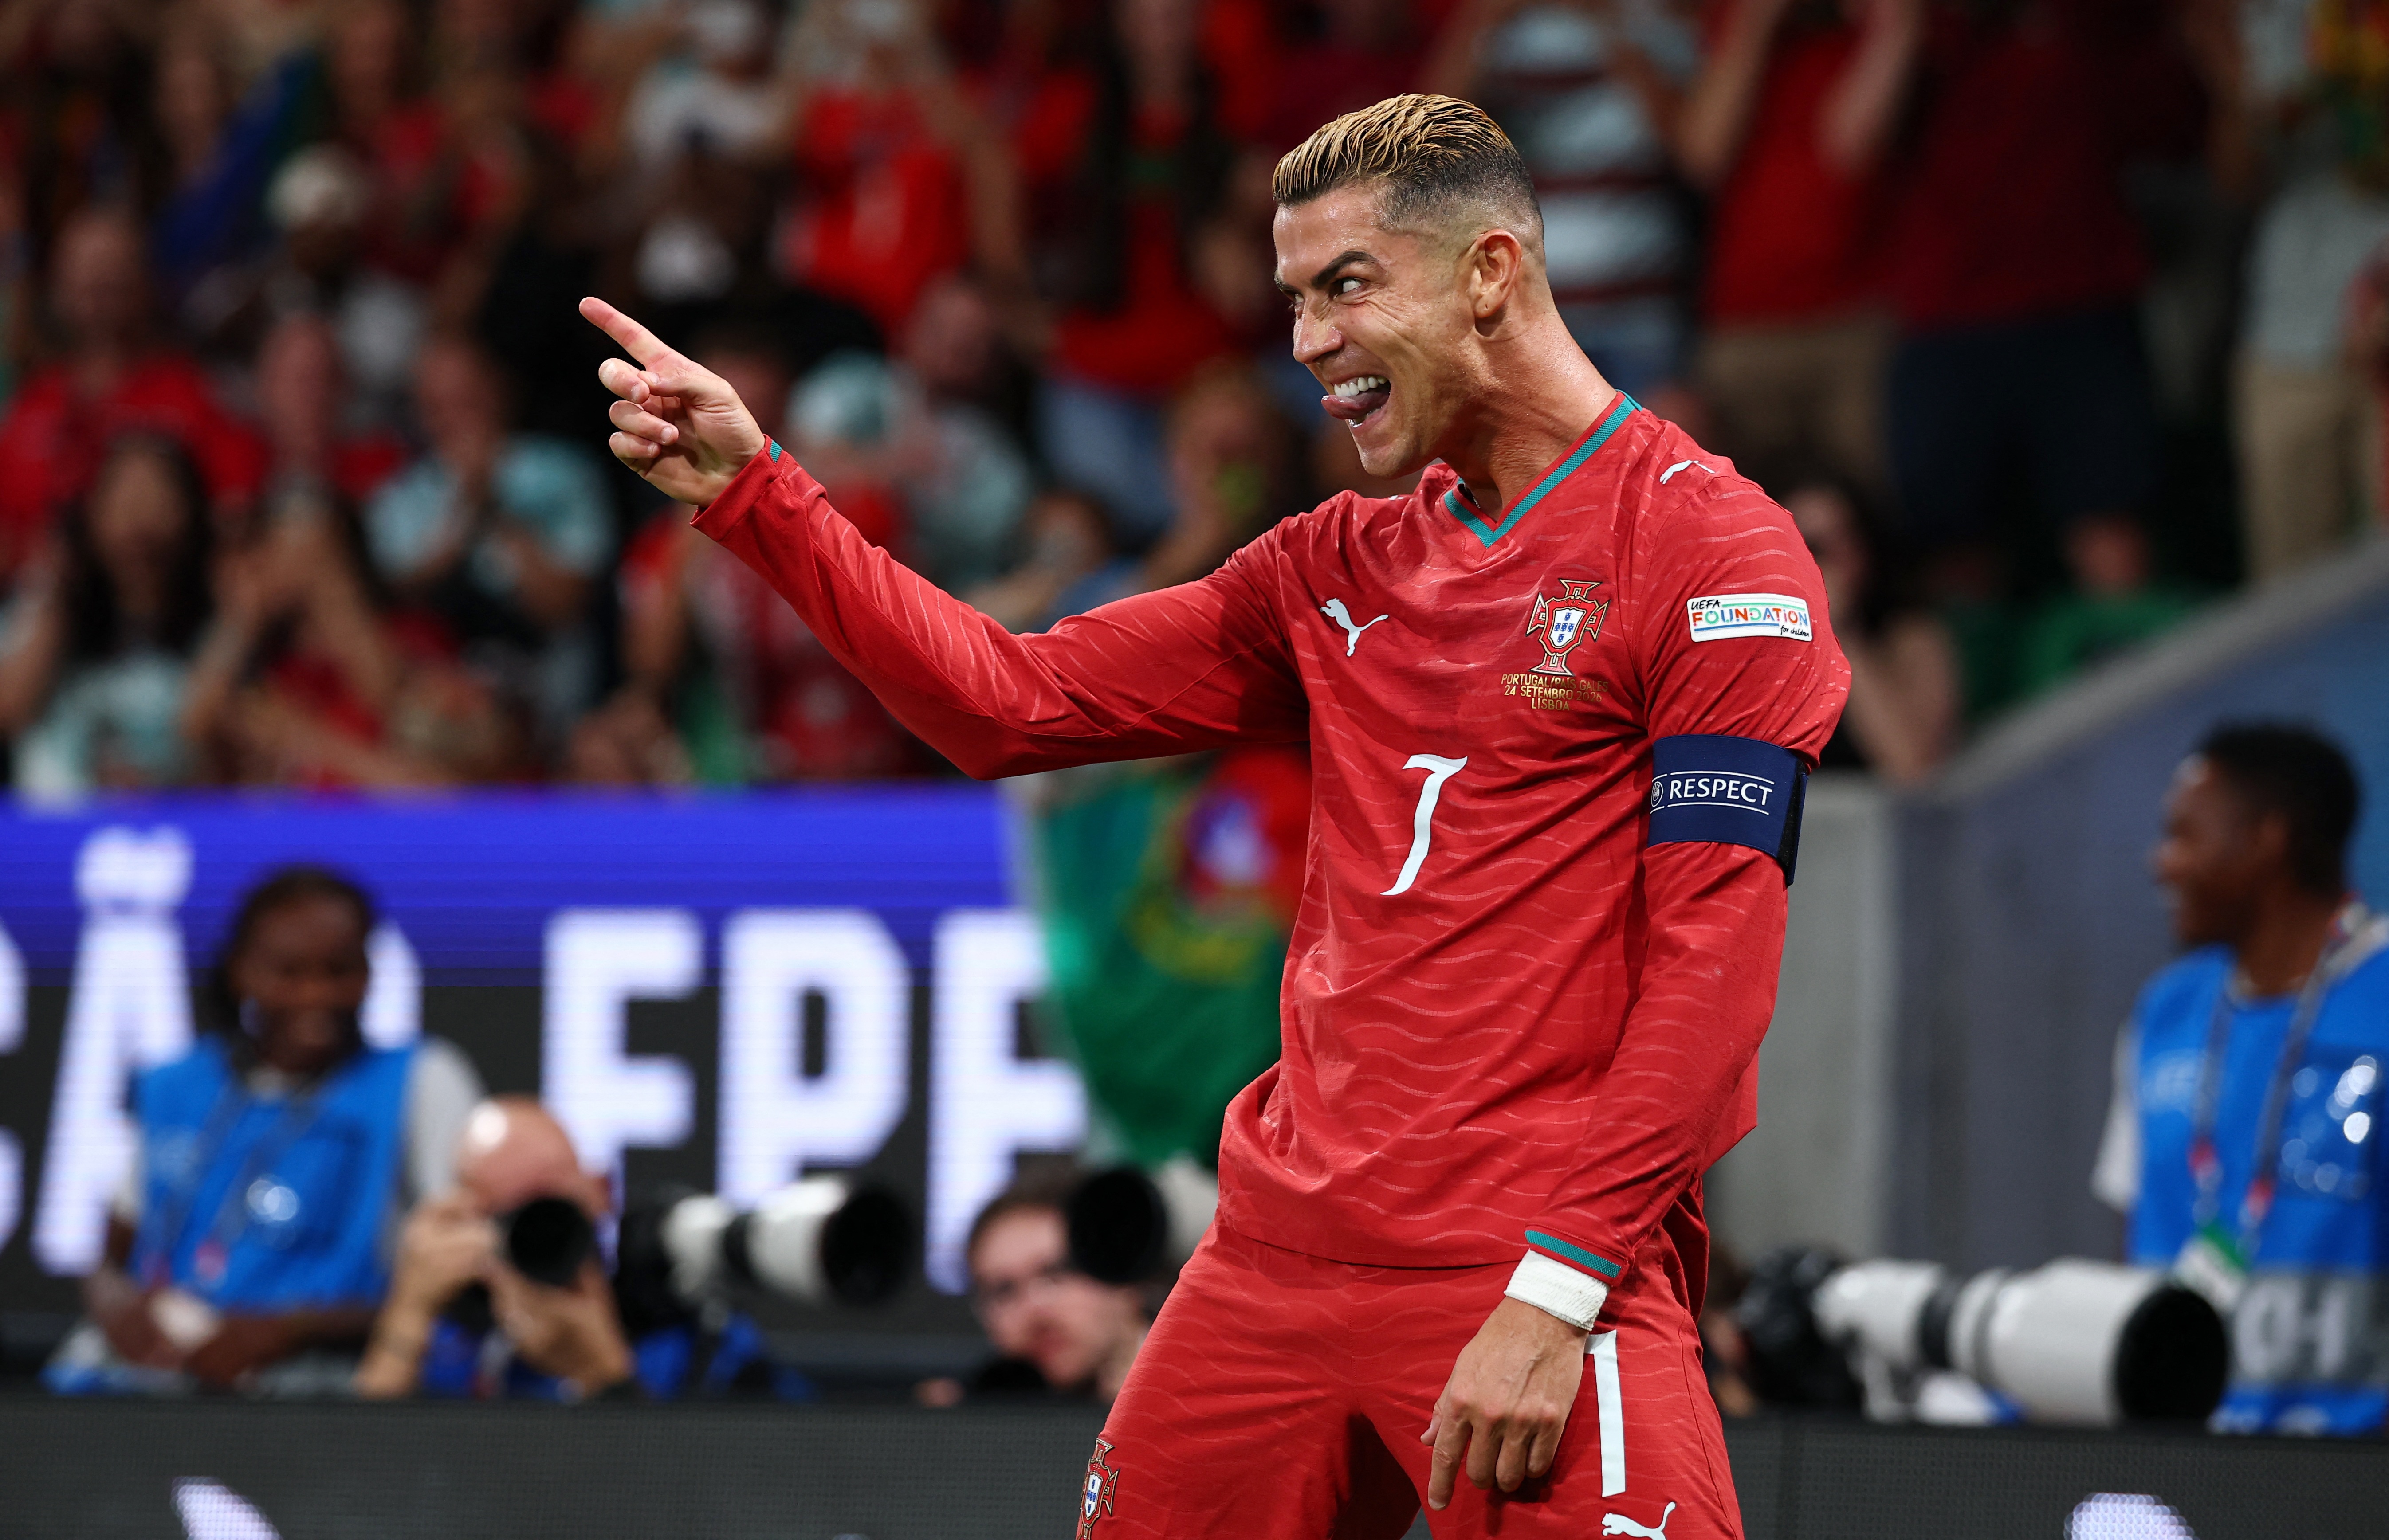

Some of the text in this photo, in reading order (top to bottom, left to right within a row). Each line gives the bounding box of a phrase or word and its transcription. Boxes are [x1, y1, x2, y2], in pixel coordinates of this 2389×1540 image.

[1691, 599, 1720, 610] UEFA
[1780, 625, 1809, 637] for children
[1580, 680, 1608, 692] GALES
[1504, 685, 1602, 703] 24 SETEMBRO 2026
[1531, 698, 1570, 711] LISBOA
[1670, 778, 1773, 806] RESPECT
[1379, 754, 1468, 896] 7
